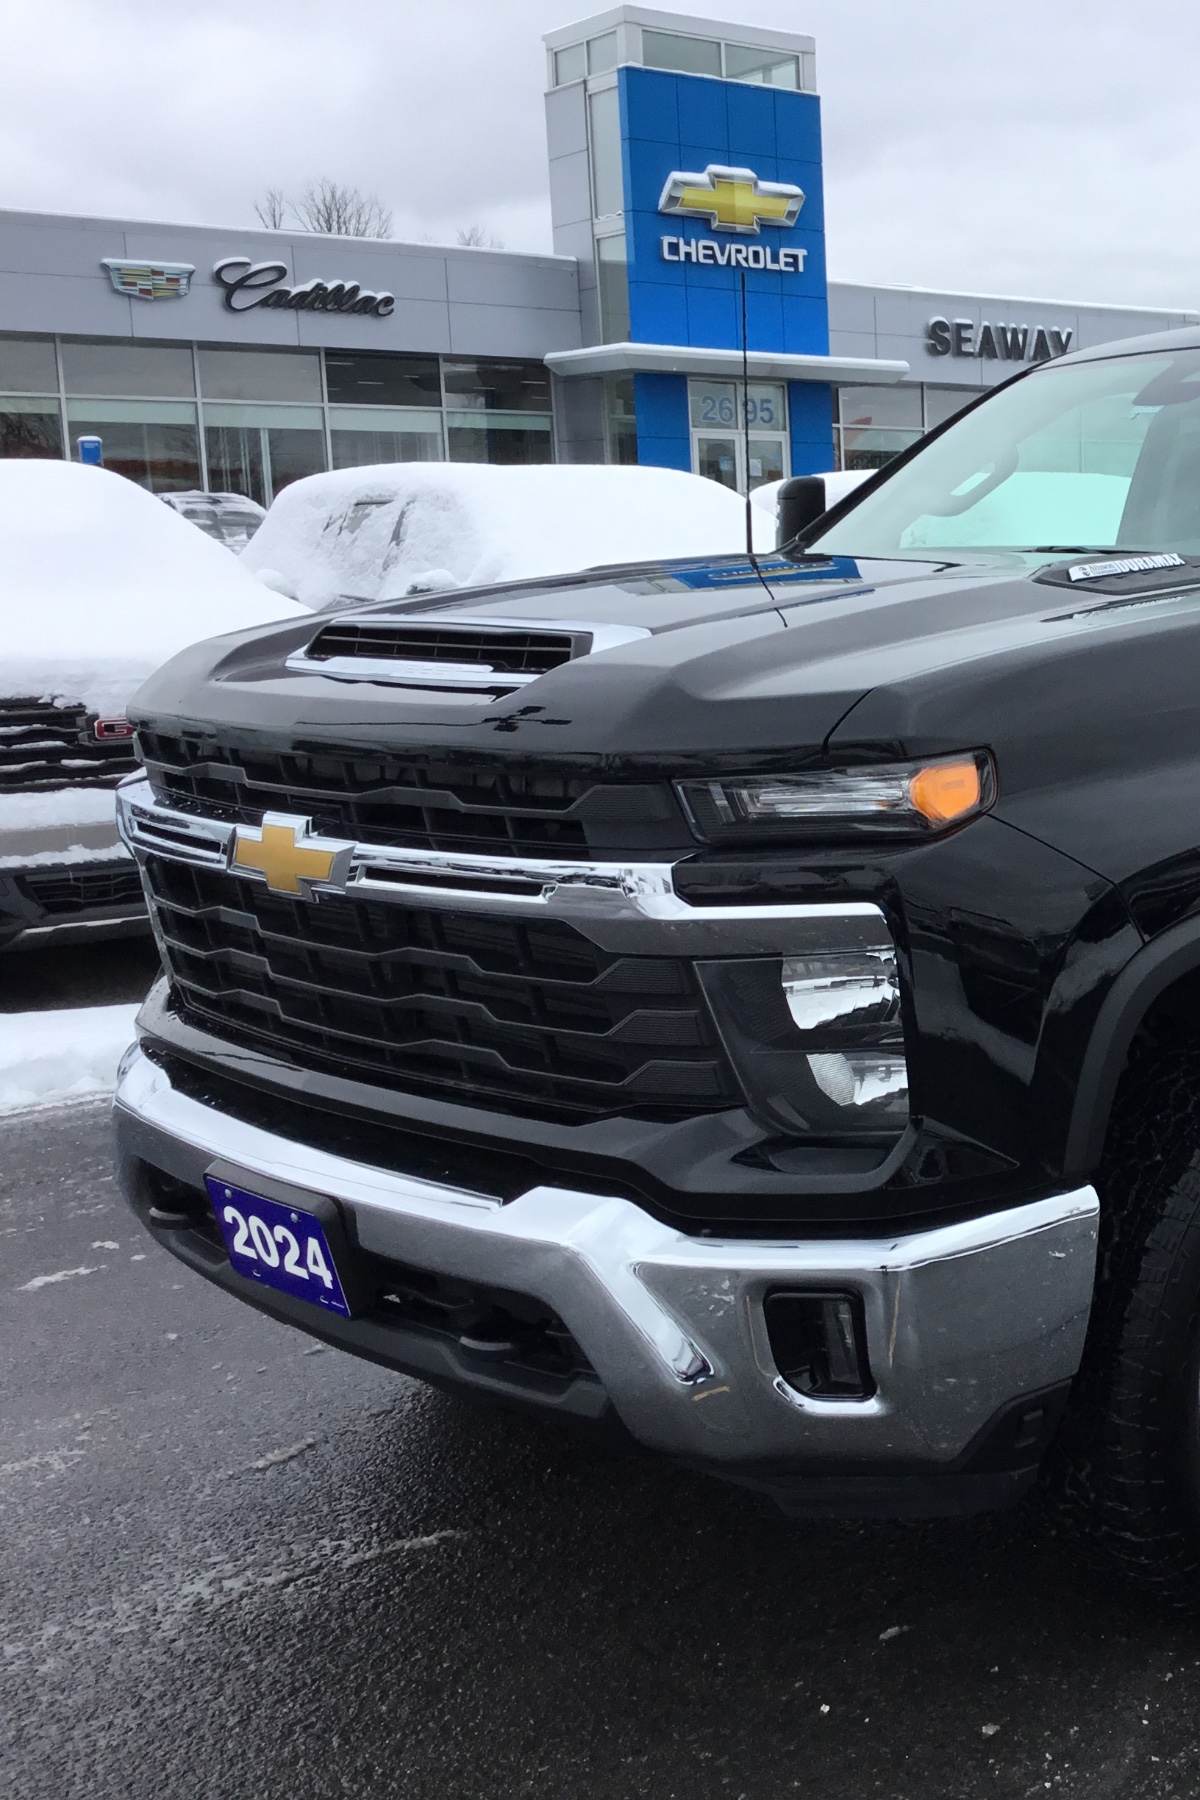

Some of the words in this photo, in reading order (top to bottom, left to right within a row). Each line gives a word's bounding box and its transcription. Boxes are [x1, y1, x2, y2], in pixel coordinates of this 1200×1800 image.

[661, 235, 808, 272] CHEVROLET
[213, 257, 395, 317] Cadillac
[926, 317, 1073, 361] SEAWAY
[701, 395, 775, 425] 2695
[1116, 553, 1185, 573] DURAMAX
[223, 1205, 334, 1290] 2024
